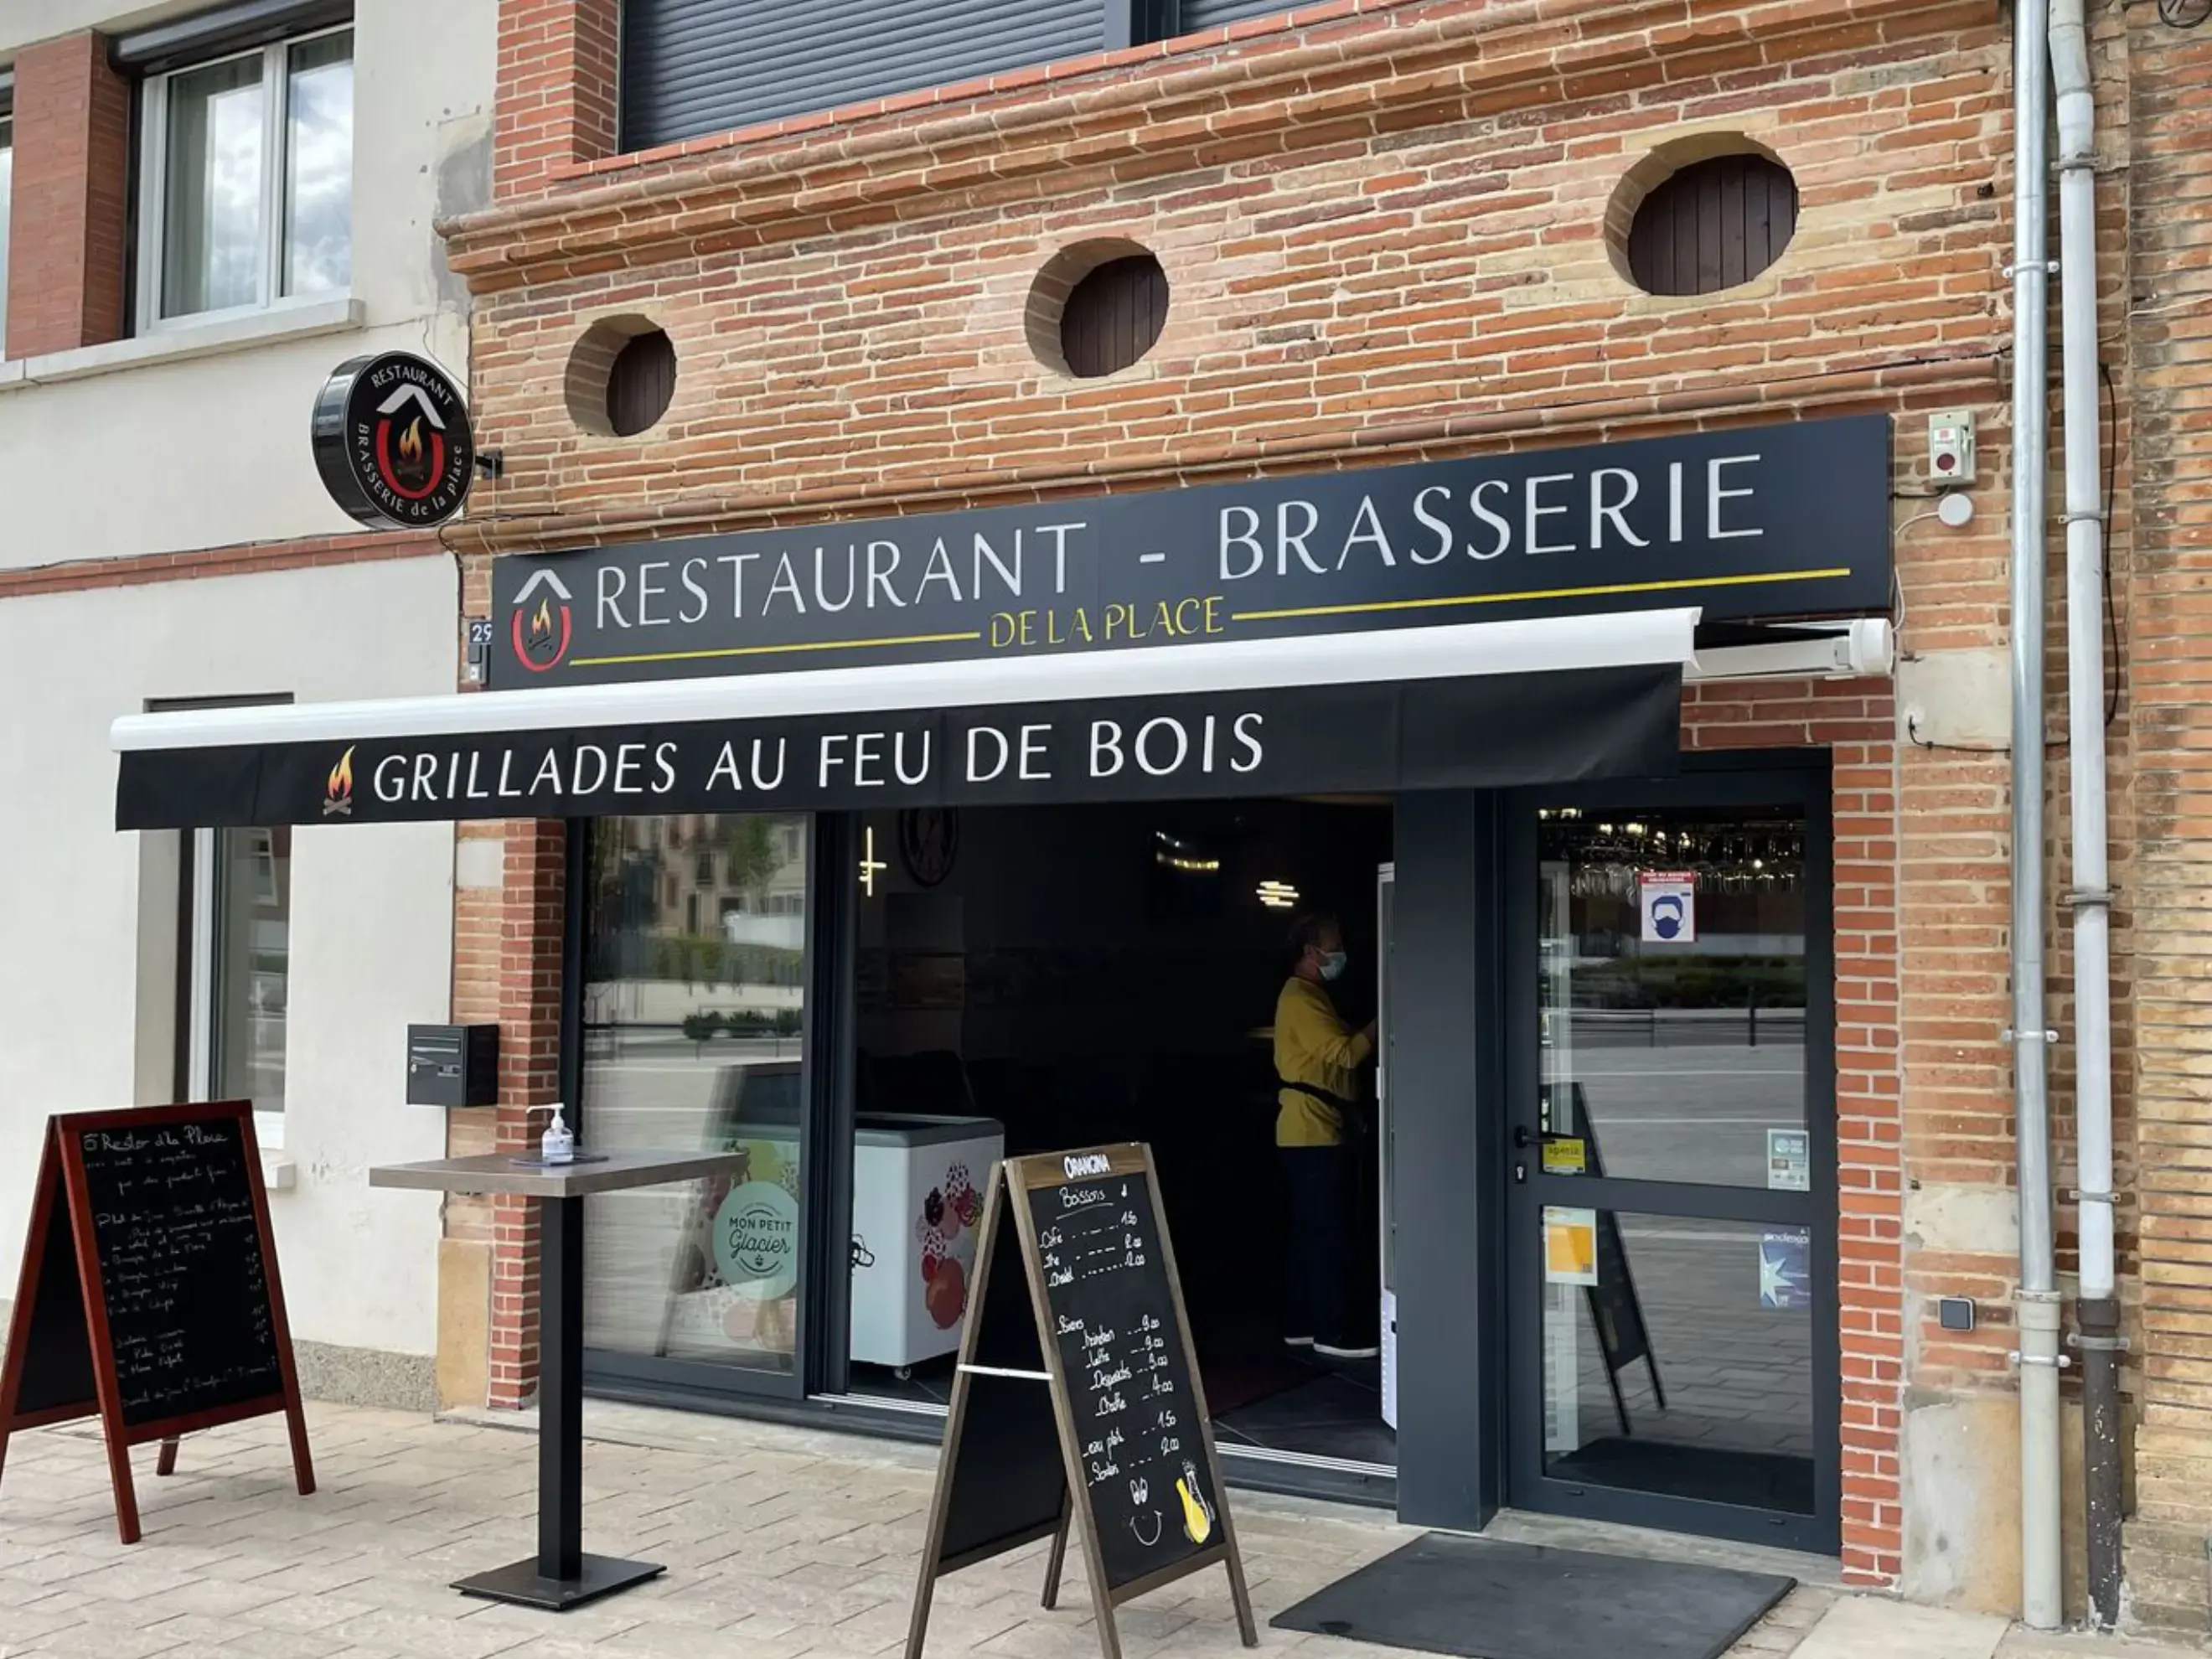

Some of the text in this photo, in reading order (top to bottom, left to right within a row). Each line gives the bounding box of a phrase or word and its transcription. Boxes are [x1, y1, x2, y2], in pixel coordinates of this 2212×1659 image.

[371, 364, 453, 406] RESTAURANT
[358, 422, 463, 516] BRASSERIE de la place
[596, 523, 1088, 630] RESTAURANT
[1219, 454, 1764, 580] BRASSERIE
[990, 596, 1224, 648] DE LA PLACE
[373, 712, 1264, 803] GRILLADES AU FEU DE BOIS
[729, 1217, 792, 1233] MON PETIT
[729, 1228, 791, 1258] Glacier
